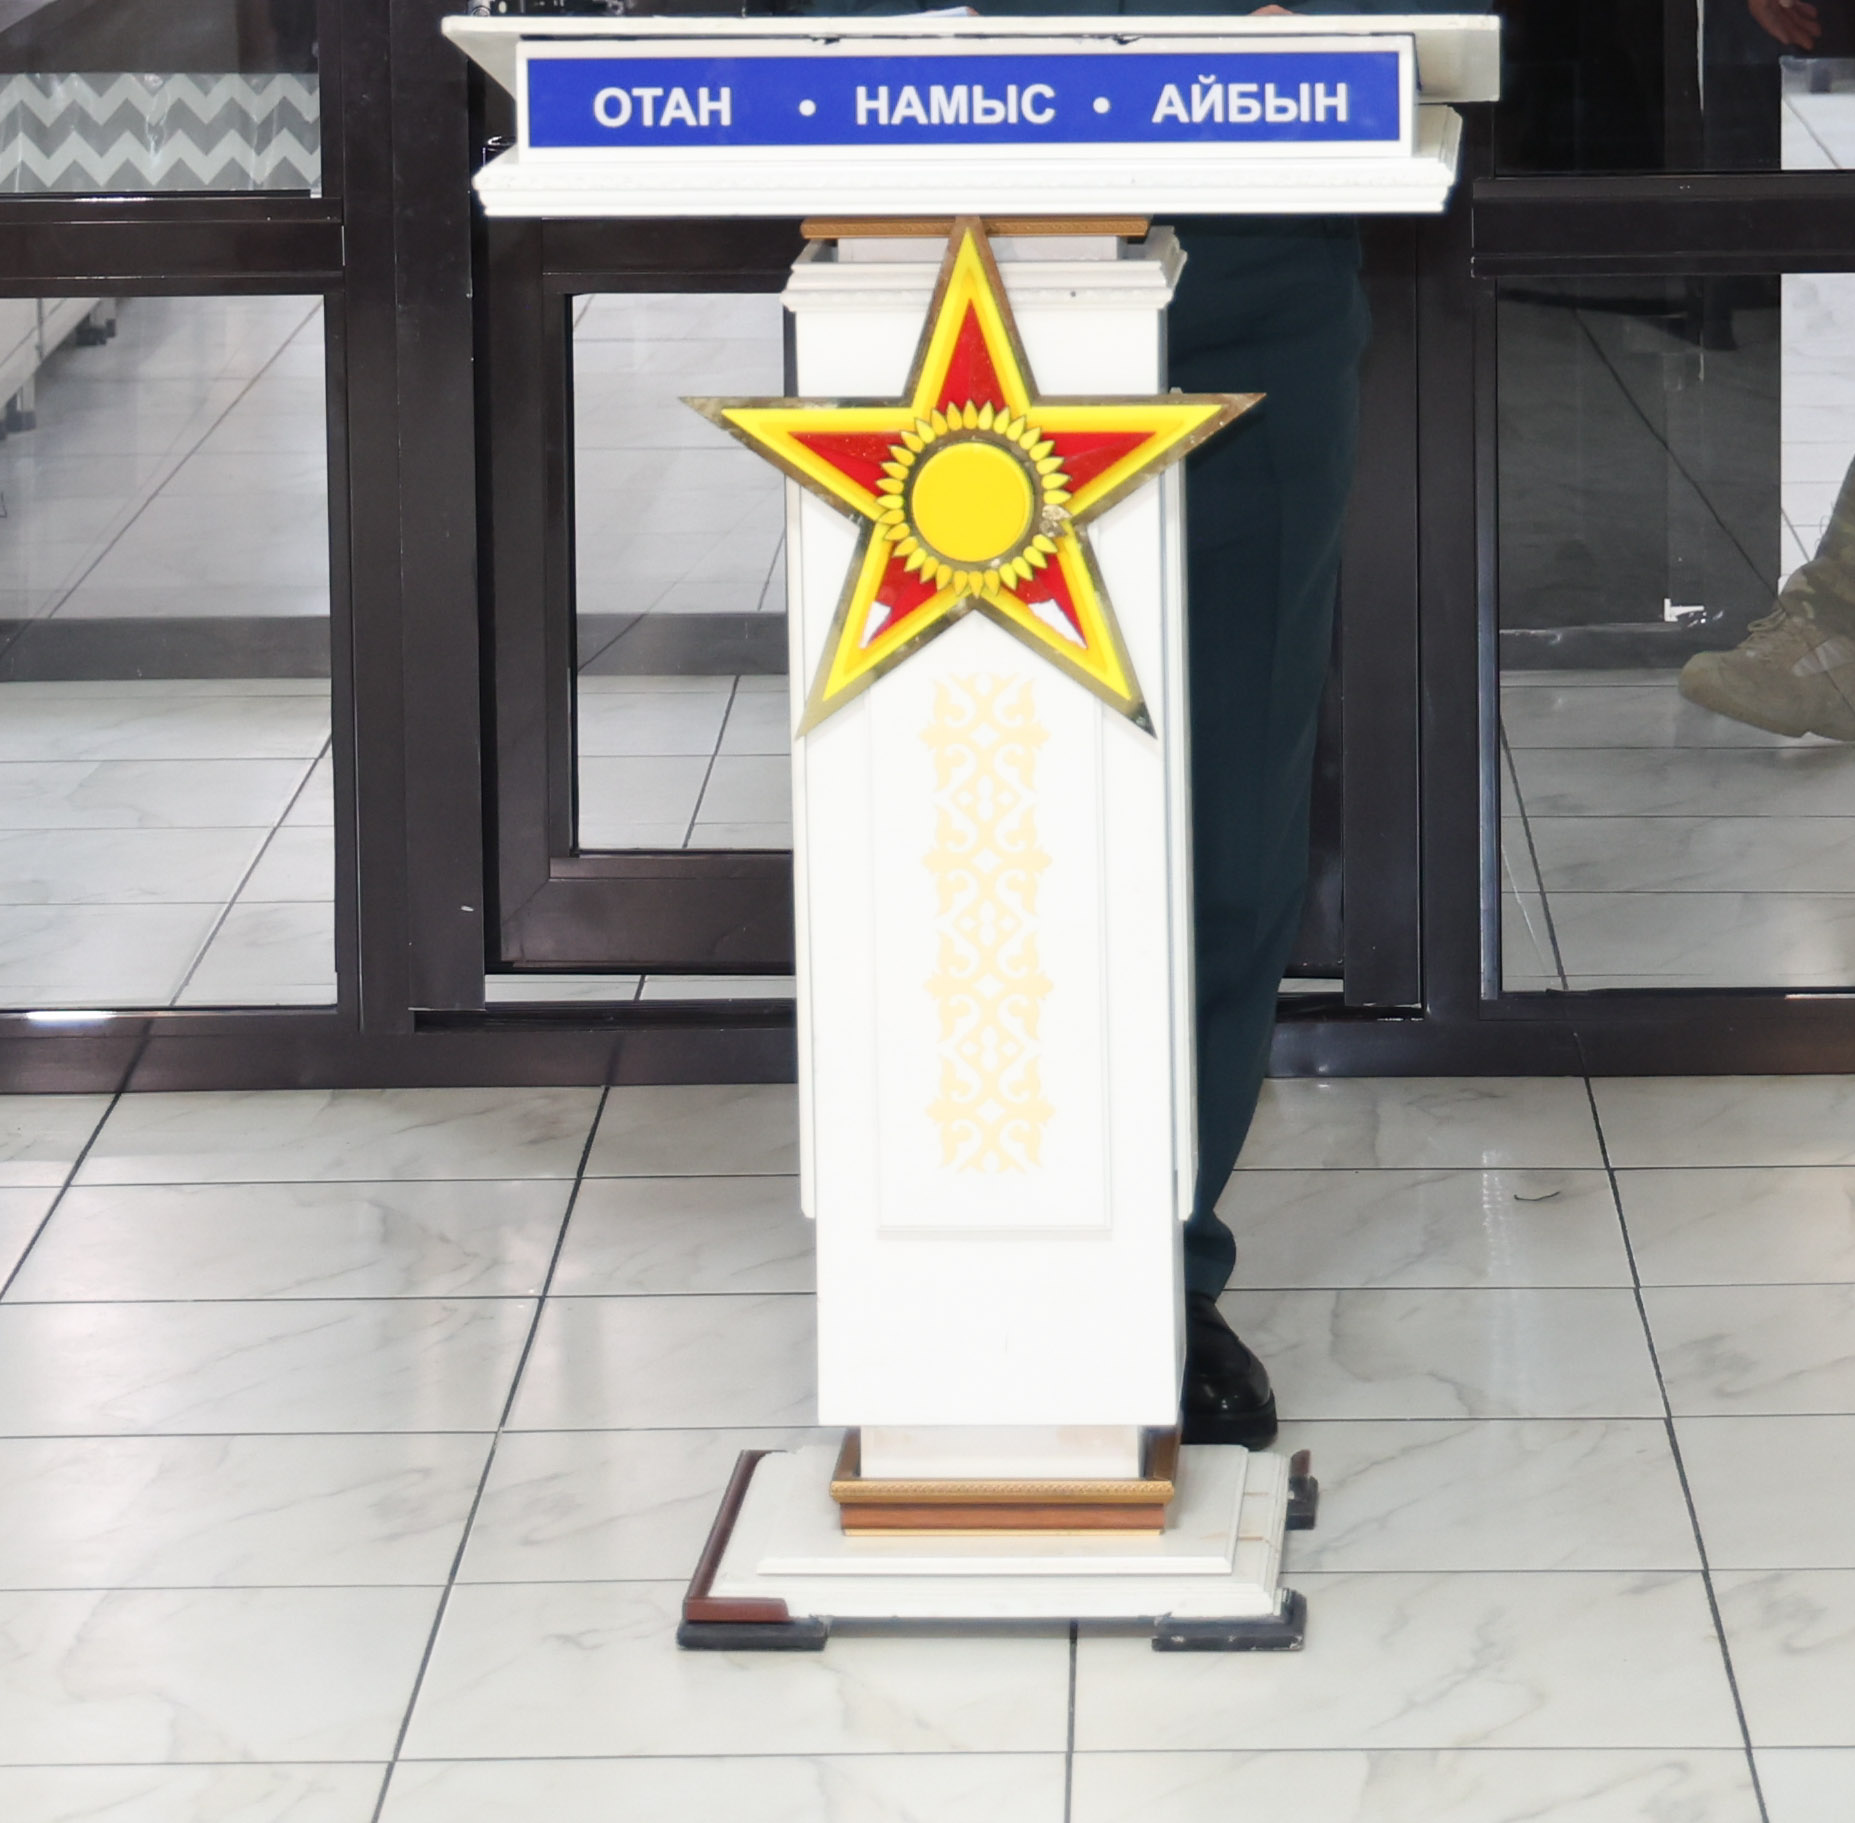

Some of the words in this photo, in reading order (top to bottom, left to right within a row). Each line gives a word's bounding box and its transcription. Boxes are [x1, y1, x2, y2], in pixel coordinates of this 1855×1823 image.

[593, 86, 732, 128] ОТАН
[855, 83, 1056, 125] НАМЫС
[1151, 74, 1349, 124] АЙБЫН
